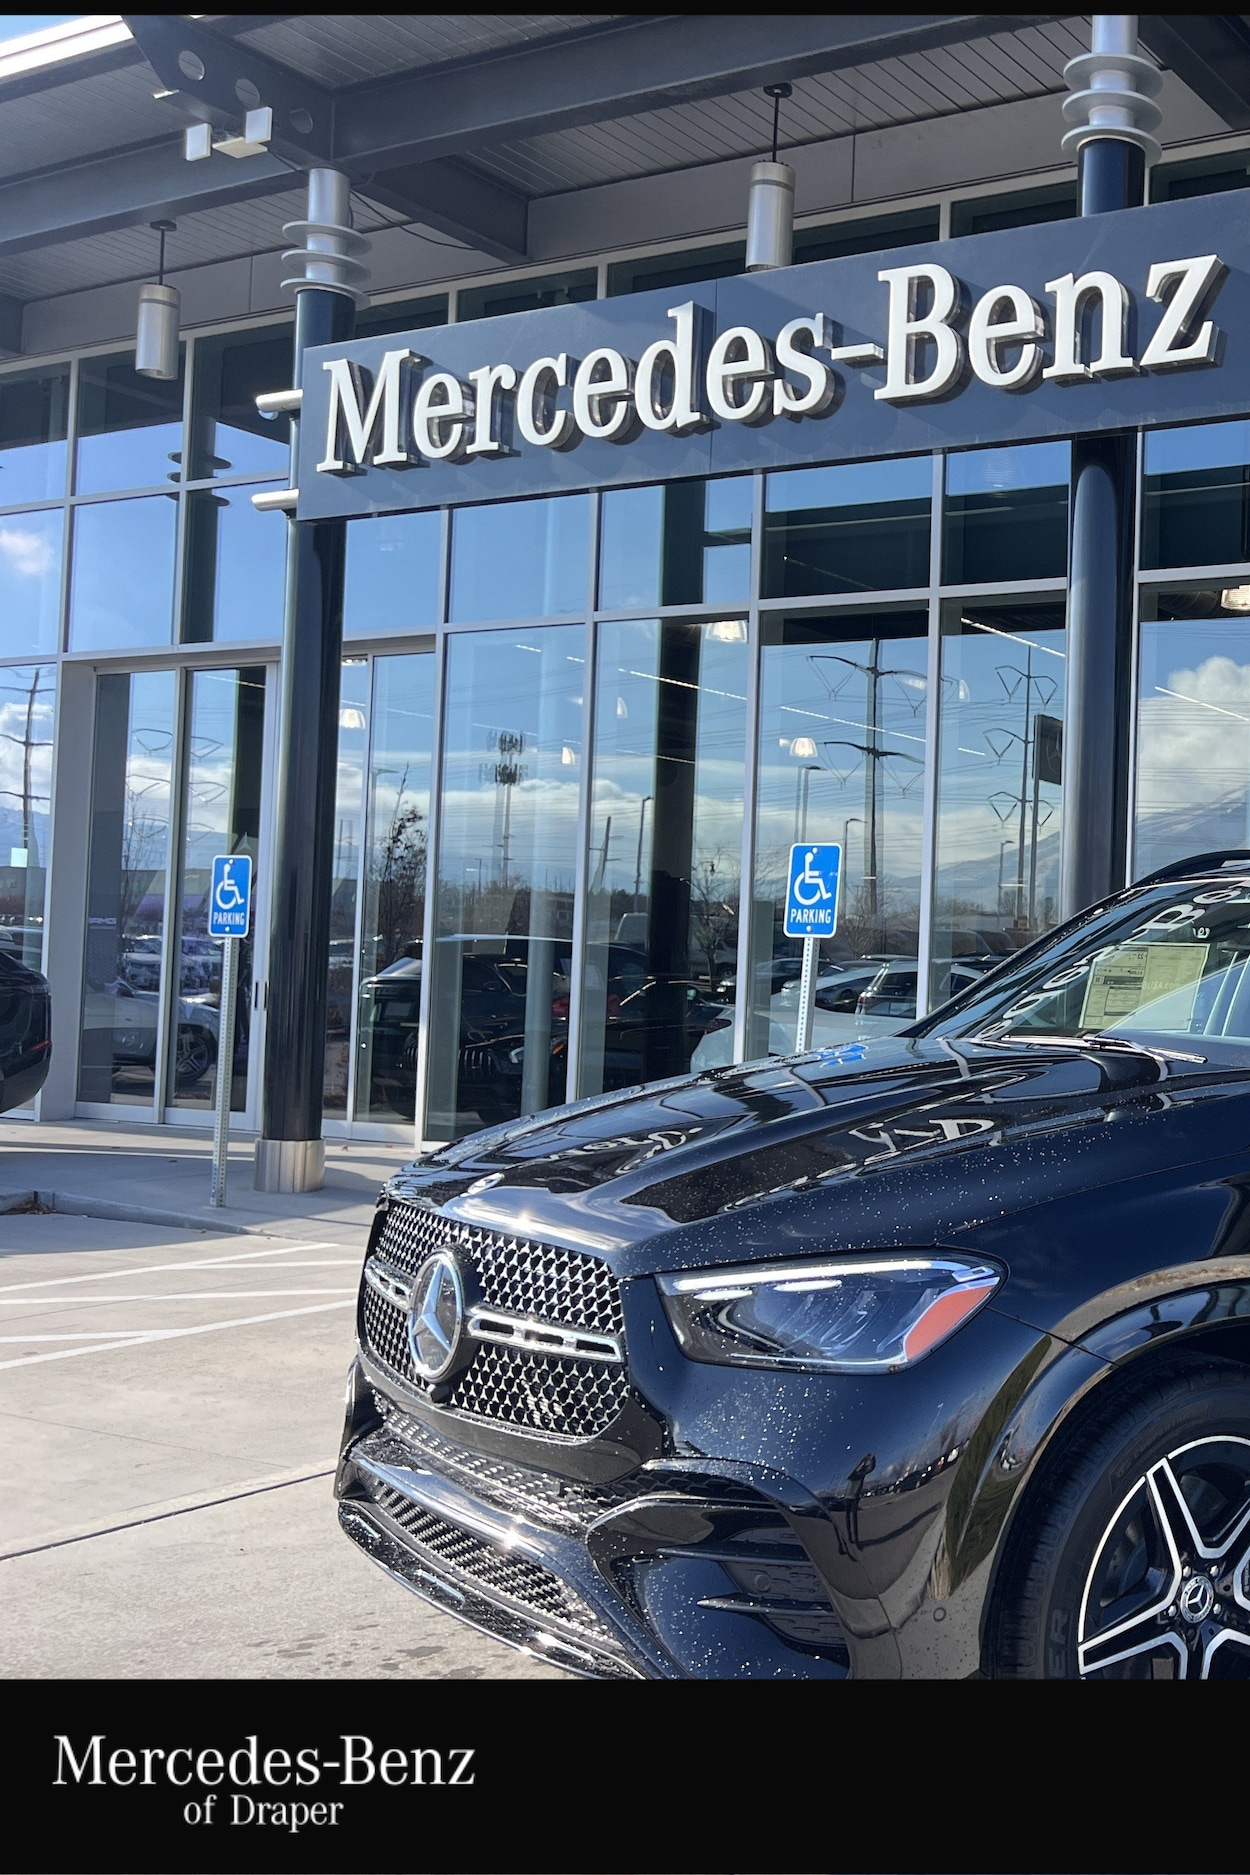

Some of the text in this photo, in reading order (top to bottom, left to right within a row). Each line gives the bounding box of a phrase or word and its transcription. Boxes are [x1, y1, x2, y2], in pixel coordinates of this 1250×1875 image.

[316, 258, 1226, 474] Mercedes-Benz
[213, 912, 245, 925] PARKING
[789, 908, 832, 924] PARKING
